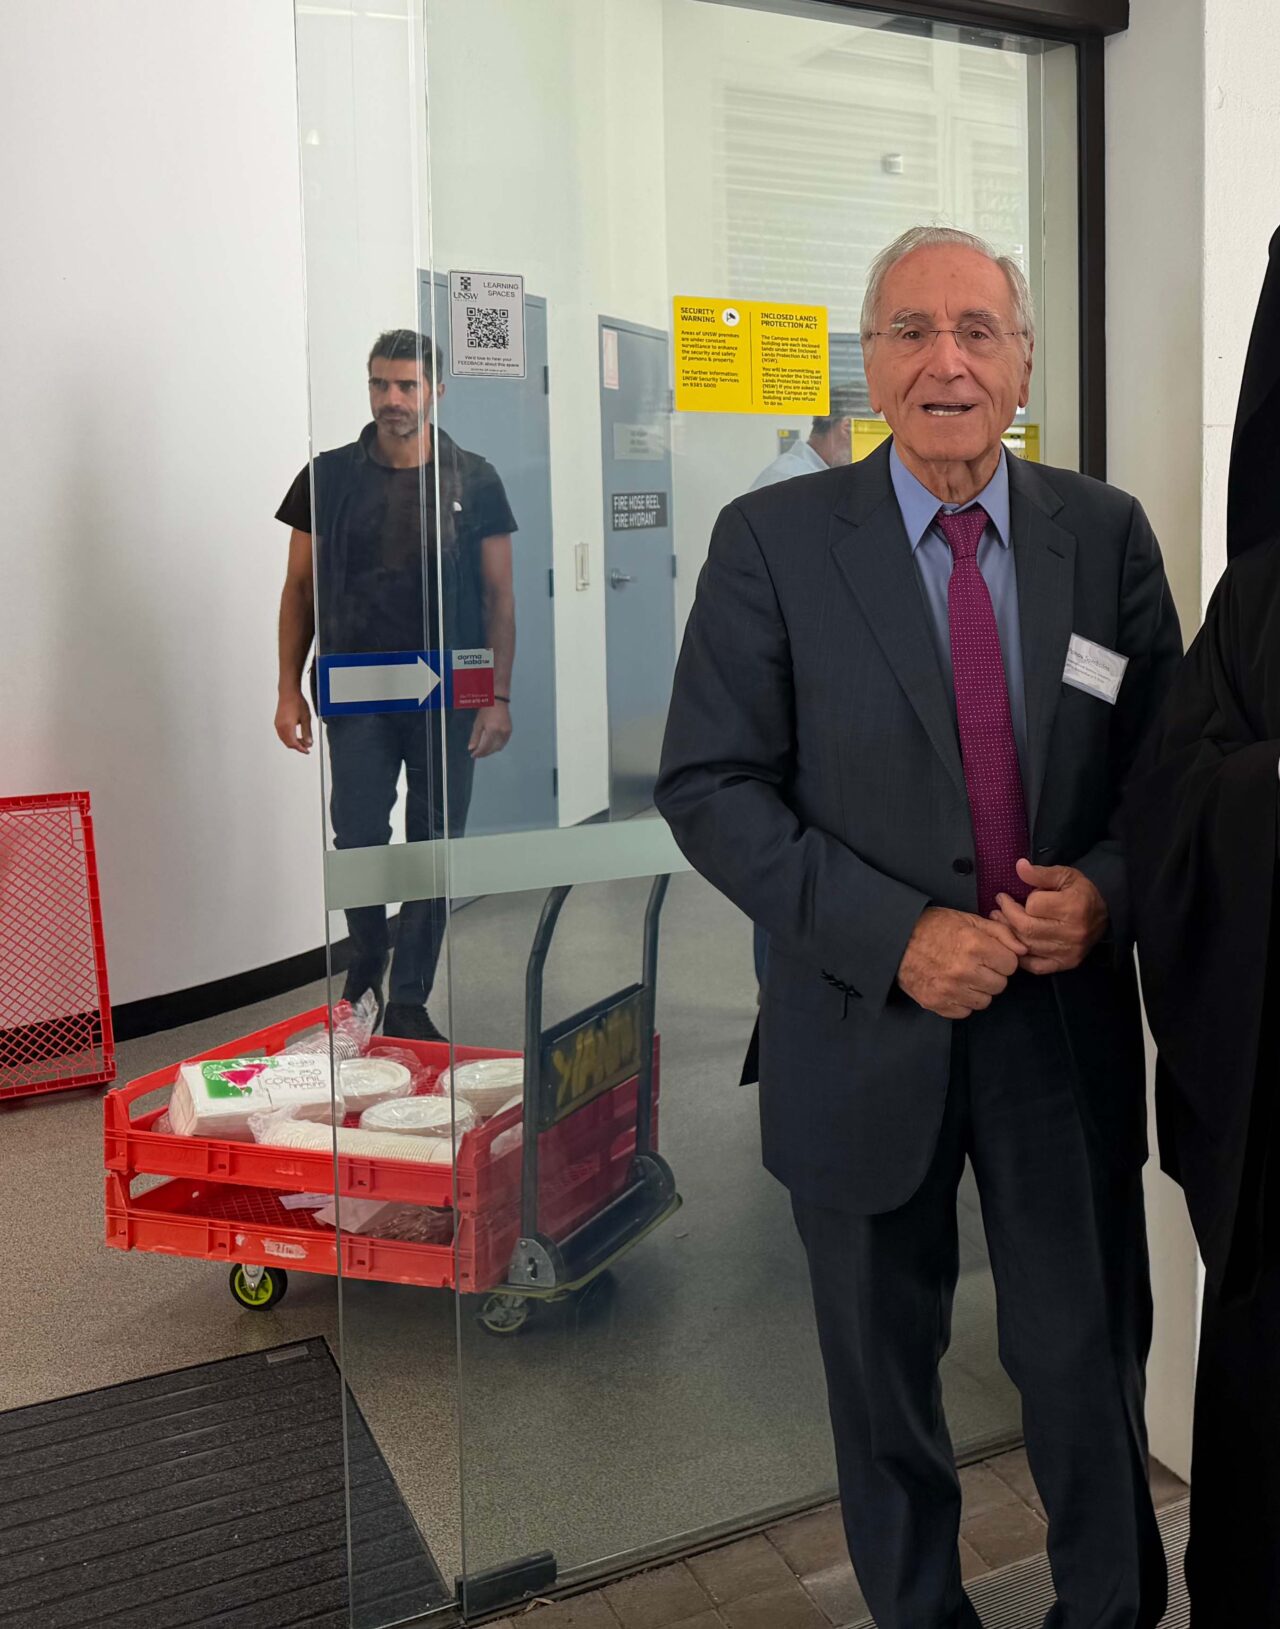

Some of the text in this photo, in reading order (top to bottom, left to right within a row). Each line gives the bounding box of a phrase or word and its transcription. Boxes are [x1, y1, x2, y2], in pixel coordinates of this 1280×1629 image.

[483, 282, 519, 290] LEARNING
[453, 291, 479, 300] UNSW
[488, 290, 515, 298] SPACES
[681, 307, 714, 315] SECURITY
[681, 315, 716, 323] WARNING
[761, 312, 818, 322] INCLOSED LANDS
[761, 320, 804, 329] PROTECTION
[613, 494, 661, 511] FIRE HOSE REEL
[614, 511, 656, 528] FIRE HYDRANT
